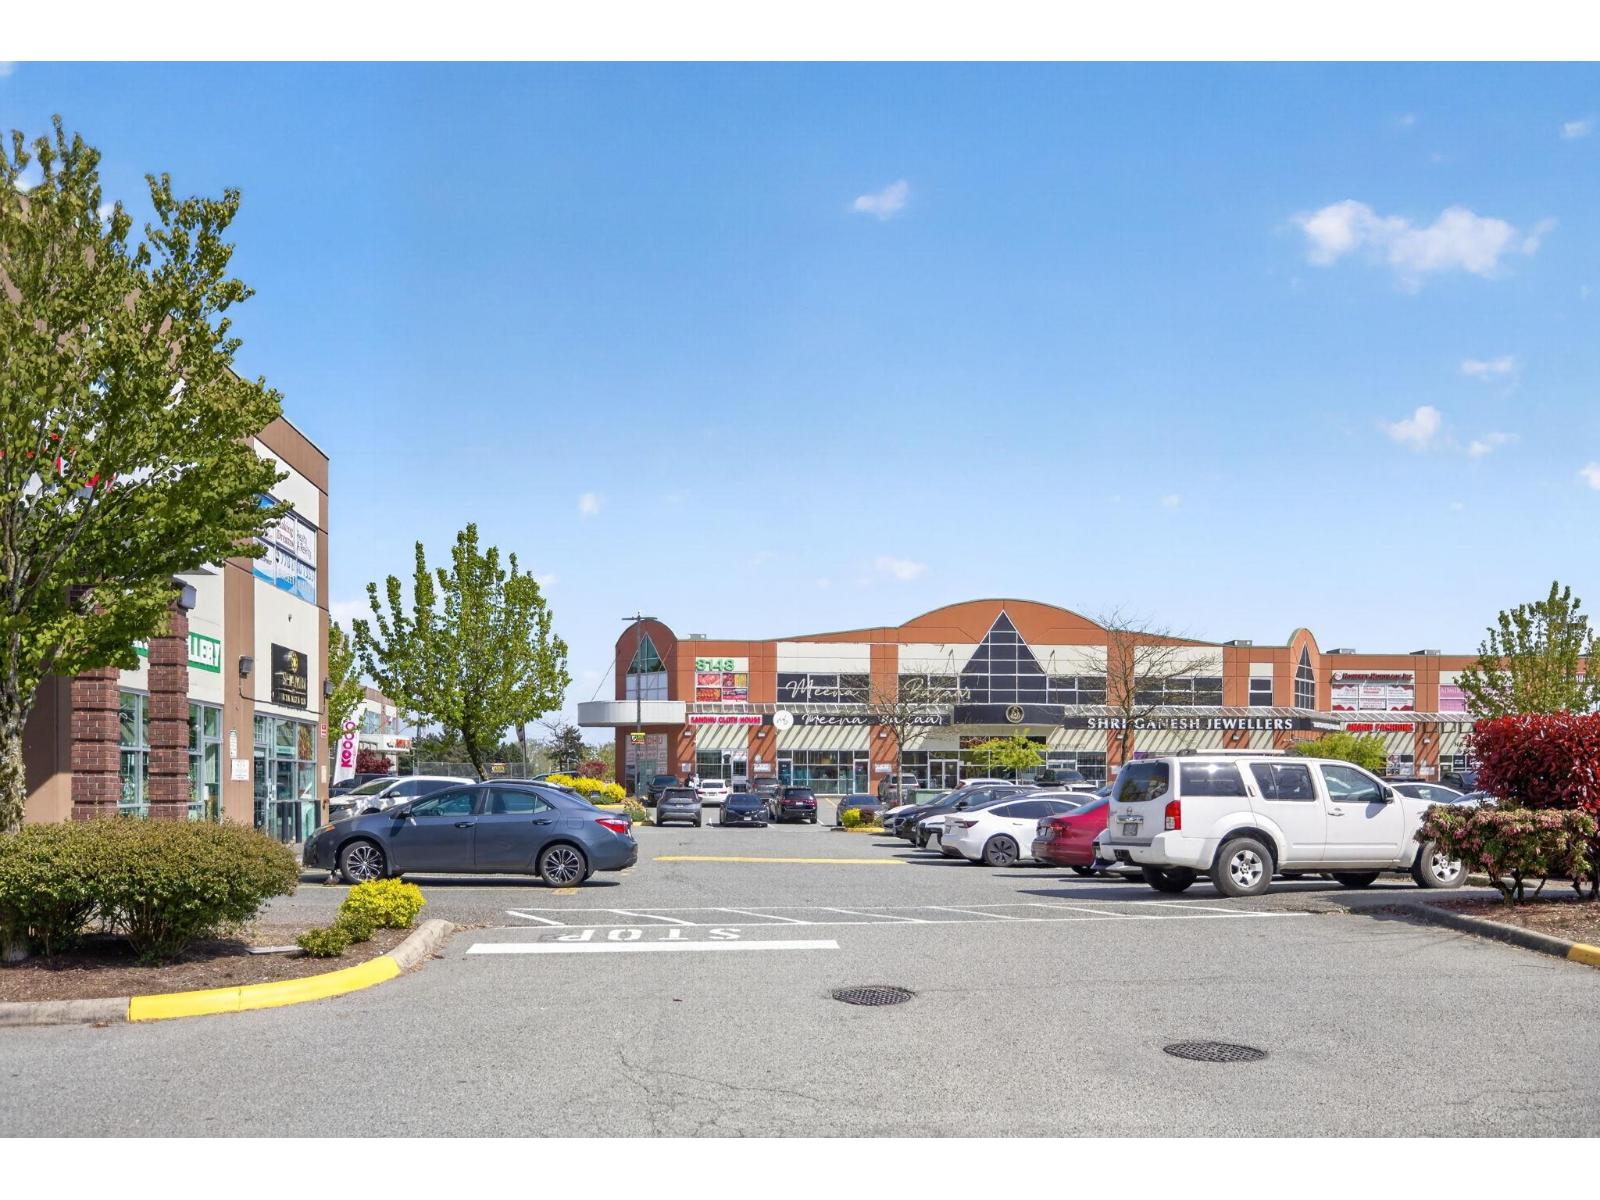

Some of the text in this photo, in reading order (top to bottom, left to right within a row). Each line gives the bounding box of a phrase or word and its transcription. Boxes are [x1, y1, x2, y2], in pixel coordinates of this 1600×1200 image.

[785, 677, 859, 699] Meena
[801, 712, 868, 725] Meena
[1087, 718, 1293, 729] SHRI GANESH JEWELLERS
[557, 928, 742, 941] STOP
